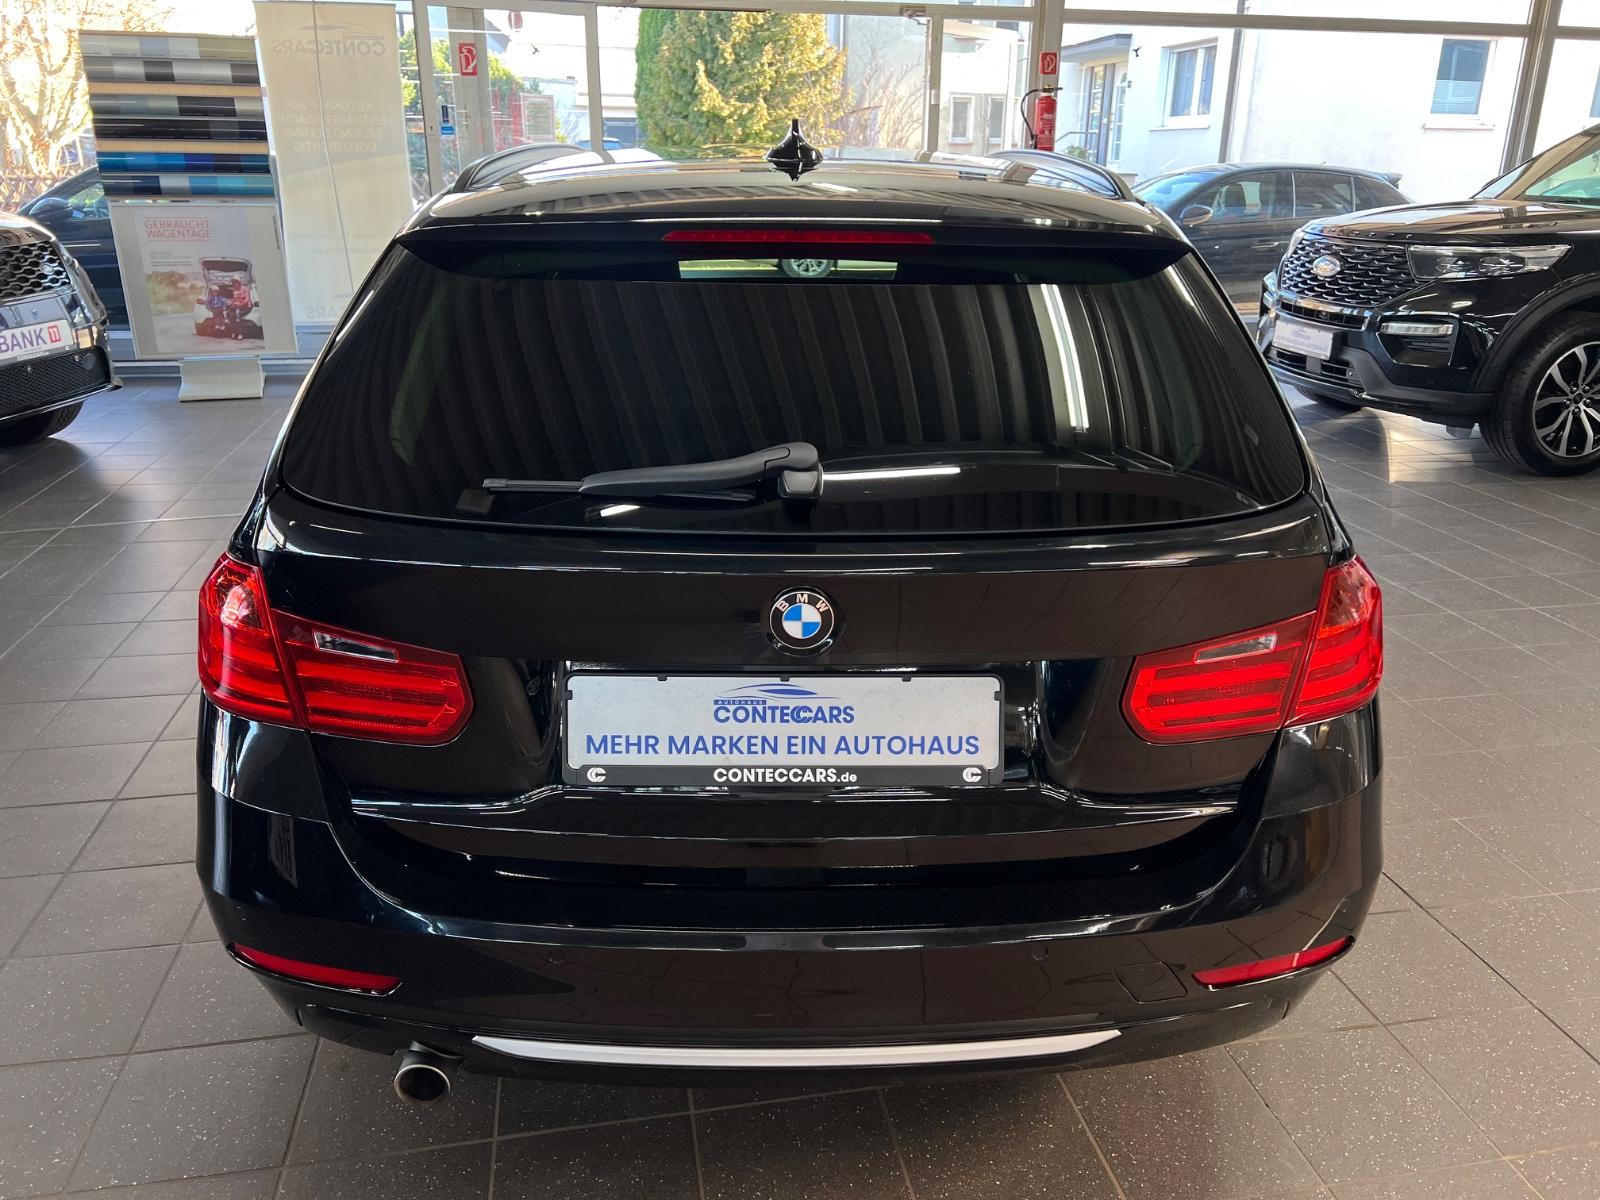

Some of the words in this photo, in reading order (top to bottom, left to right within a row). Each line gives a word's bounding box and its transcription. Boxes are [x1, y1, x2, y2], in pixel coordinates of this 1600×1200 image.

[144, 218, 209, 230] GEBRAUCHT
[146, 228, 212, 240] WAGENTAGE
[0, 328, 47, 353] BANK
[776, 593, 829, 612] BMW
[586, 734, 660, 755] MEHR
[668, 735, 778, 755] MARKEN
[786, 735, 826, 755] EIN
[834, 735, 980, 755] AUTOHAUS
[713, 767, 858, 783] CONTECCARS.de
